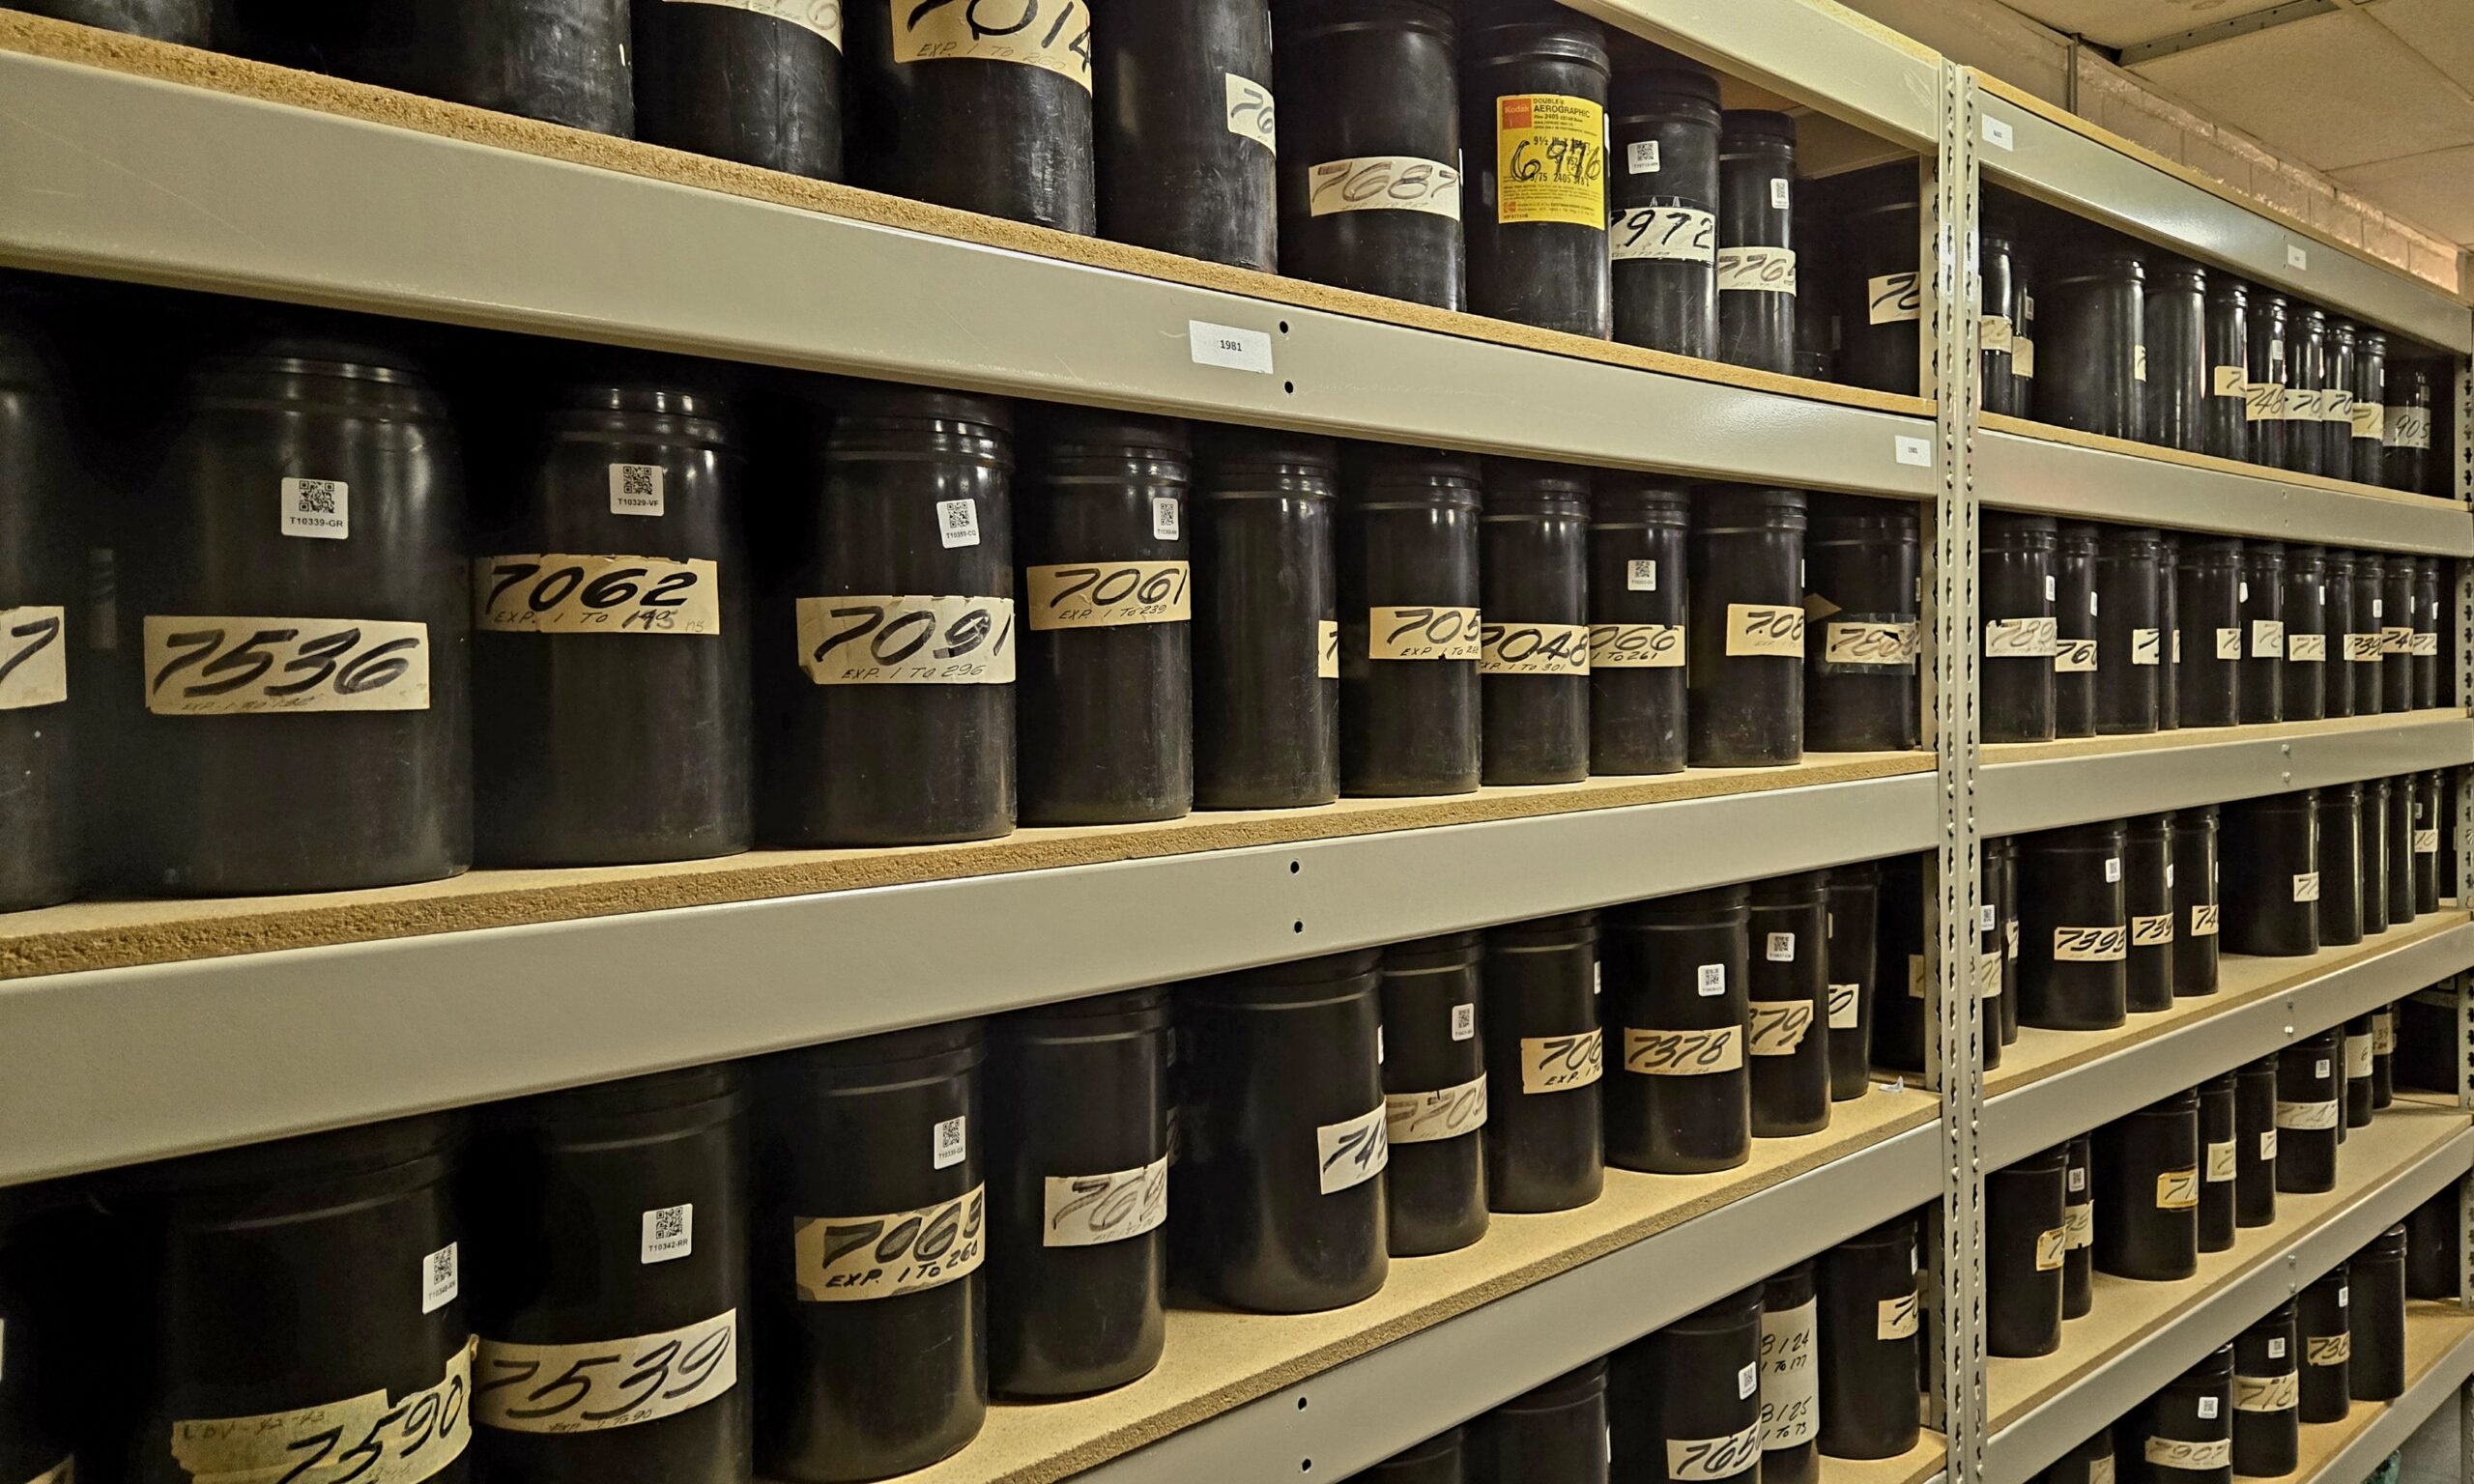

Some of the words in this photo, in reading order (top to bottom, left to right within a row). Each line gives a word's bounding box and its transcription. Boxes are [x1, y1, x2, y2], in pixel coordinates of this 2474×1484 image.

[1534, 105, 1590, 118] AEROGRAPHIC
[1312, 161, 1457, 203] 7687
[1220, 340, 1242, 352] 1981
[290, 518, 343, 528] T10339-GR
[485, 563, 698, 614] 7062
[1050, 568, 1188, 608] 7061
[494, 612, 536, 623] EXP.
[554, 613, 565, 622] 1
[580, 613, 609, 623] TO
[1058, 610, 1093, 619] EXP.
[814, 606, 1012, 667] 7091
[153, 627, 420, 698] 7536
[1627, 652, 1658, 661] 261
[841, 668, 878, 679] EXP.
[890, 668, 902, 679] 1
[909, 667, 935, 678] TO
[941, 664, 986, 677] 296
[1629, 1032, 1731, 1069] 7378
[1544, 1072, 1579, 1086] EXP.
[649, 1239, 688, 1253] T10342-RR
[825, 1269, 879, 1288] EXP.
[898, 1268, 910, 1282] 1
[916, 1261, 941, 1279] TO
[480, 1326, 730, 1421] 7539
[276, 1374, 462, 1484] 7590
